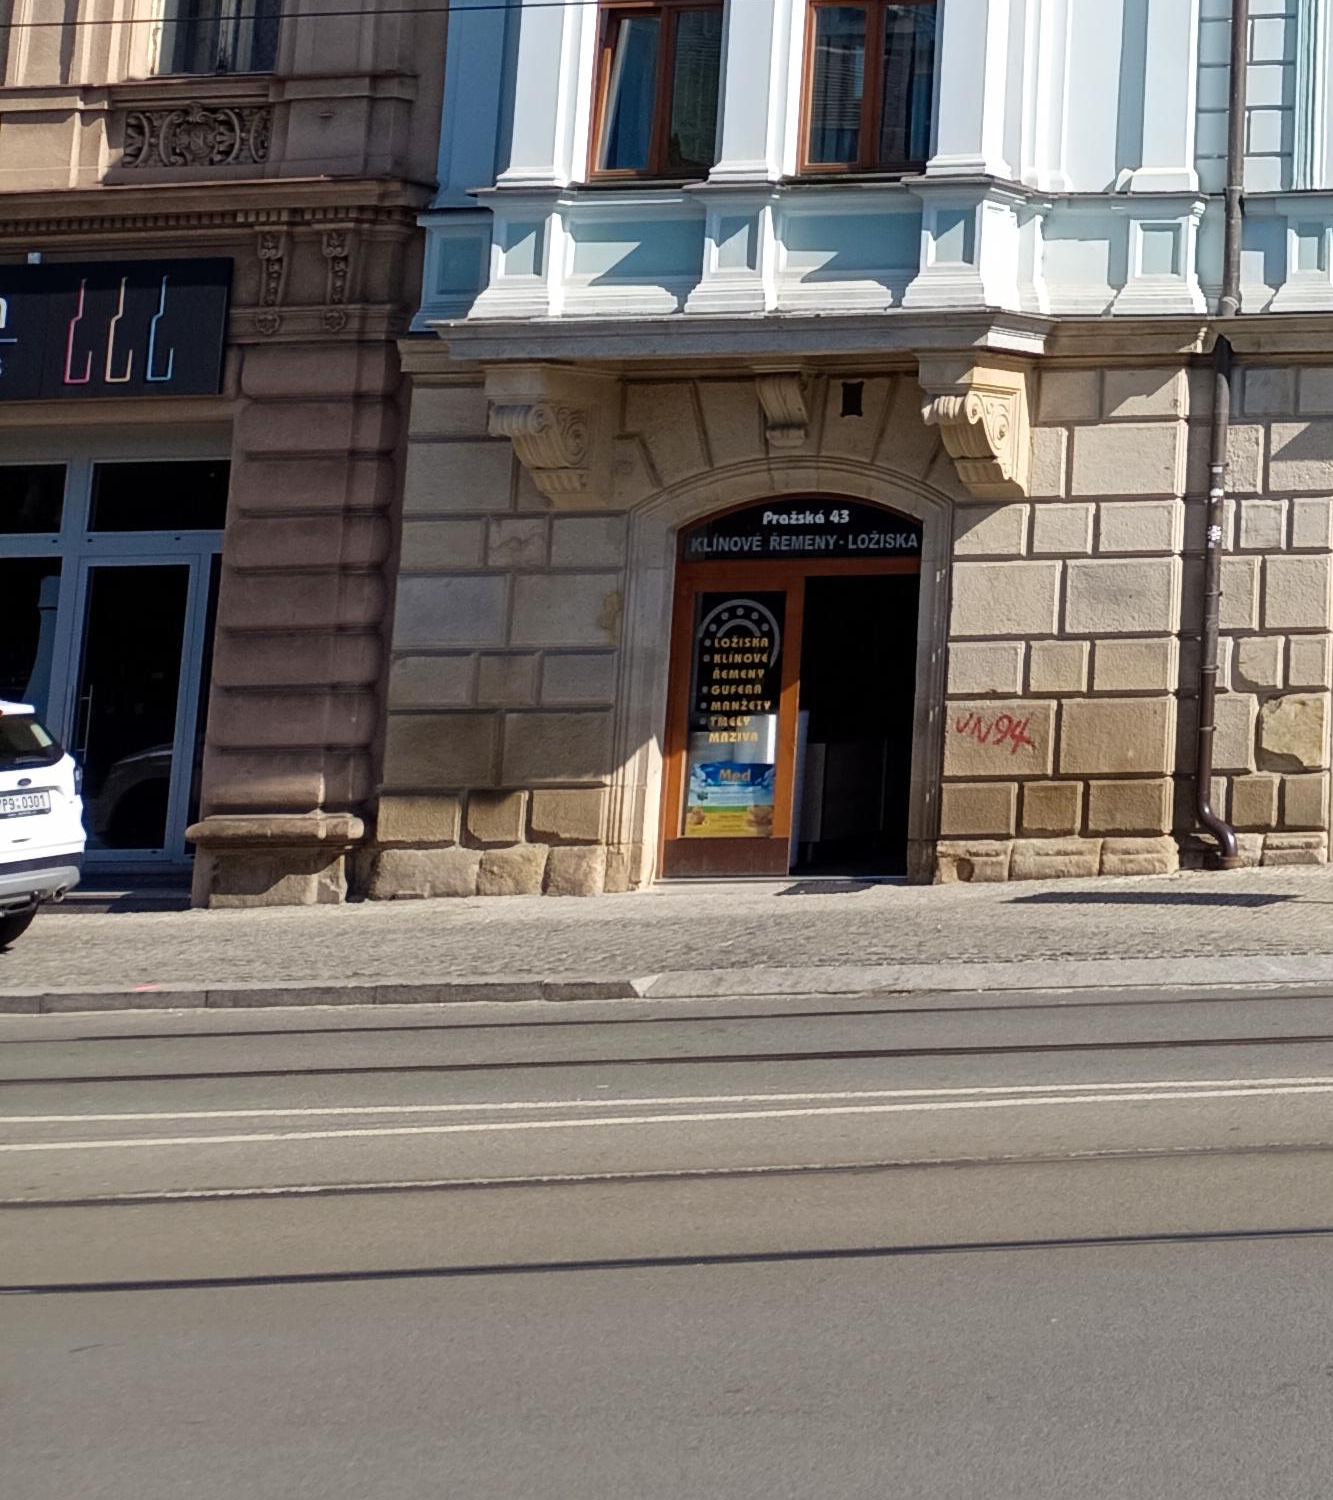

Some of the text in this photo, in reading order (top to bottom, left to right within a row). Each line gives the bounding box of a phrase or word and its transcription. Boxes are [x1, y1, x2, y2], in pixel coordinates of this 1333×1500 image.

[762, 509, 850, 525] Pražská 43
[691, 533, 762, 552] KLÍNOVÉ
[769, 531, 838, 551] ŘEMENY
[848, 530, 919, 550] LOŽISKA
[714, 635, 769, 648] LOŽISKA
[713, 650, 769, 664] KLÍNOVÉ
[712, 666, 765, 680] ŘEMENY
[710, 684, 763, 696] GUFERA
[710, 698, 772, 712] MANŽETY
[709, 715, 753, 728] TMELY
[708, 731, 759, 744] MAZIVA
[720, 768, 752, 782] Med
[21, 794, 46, 809] 0301
